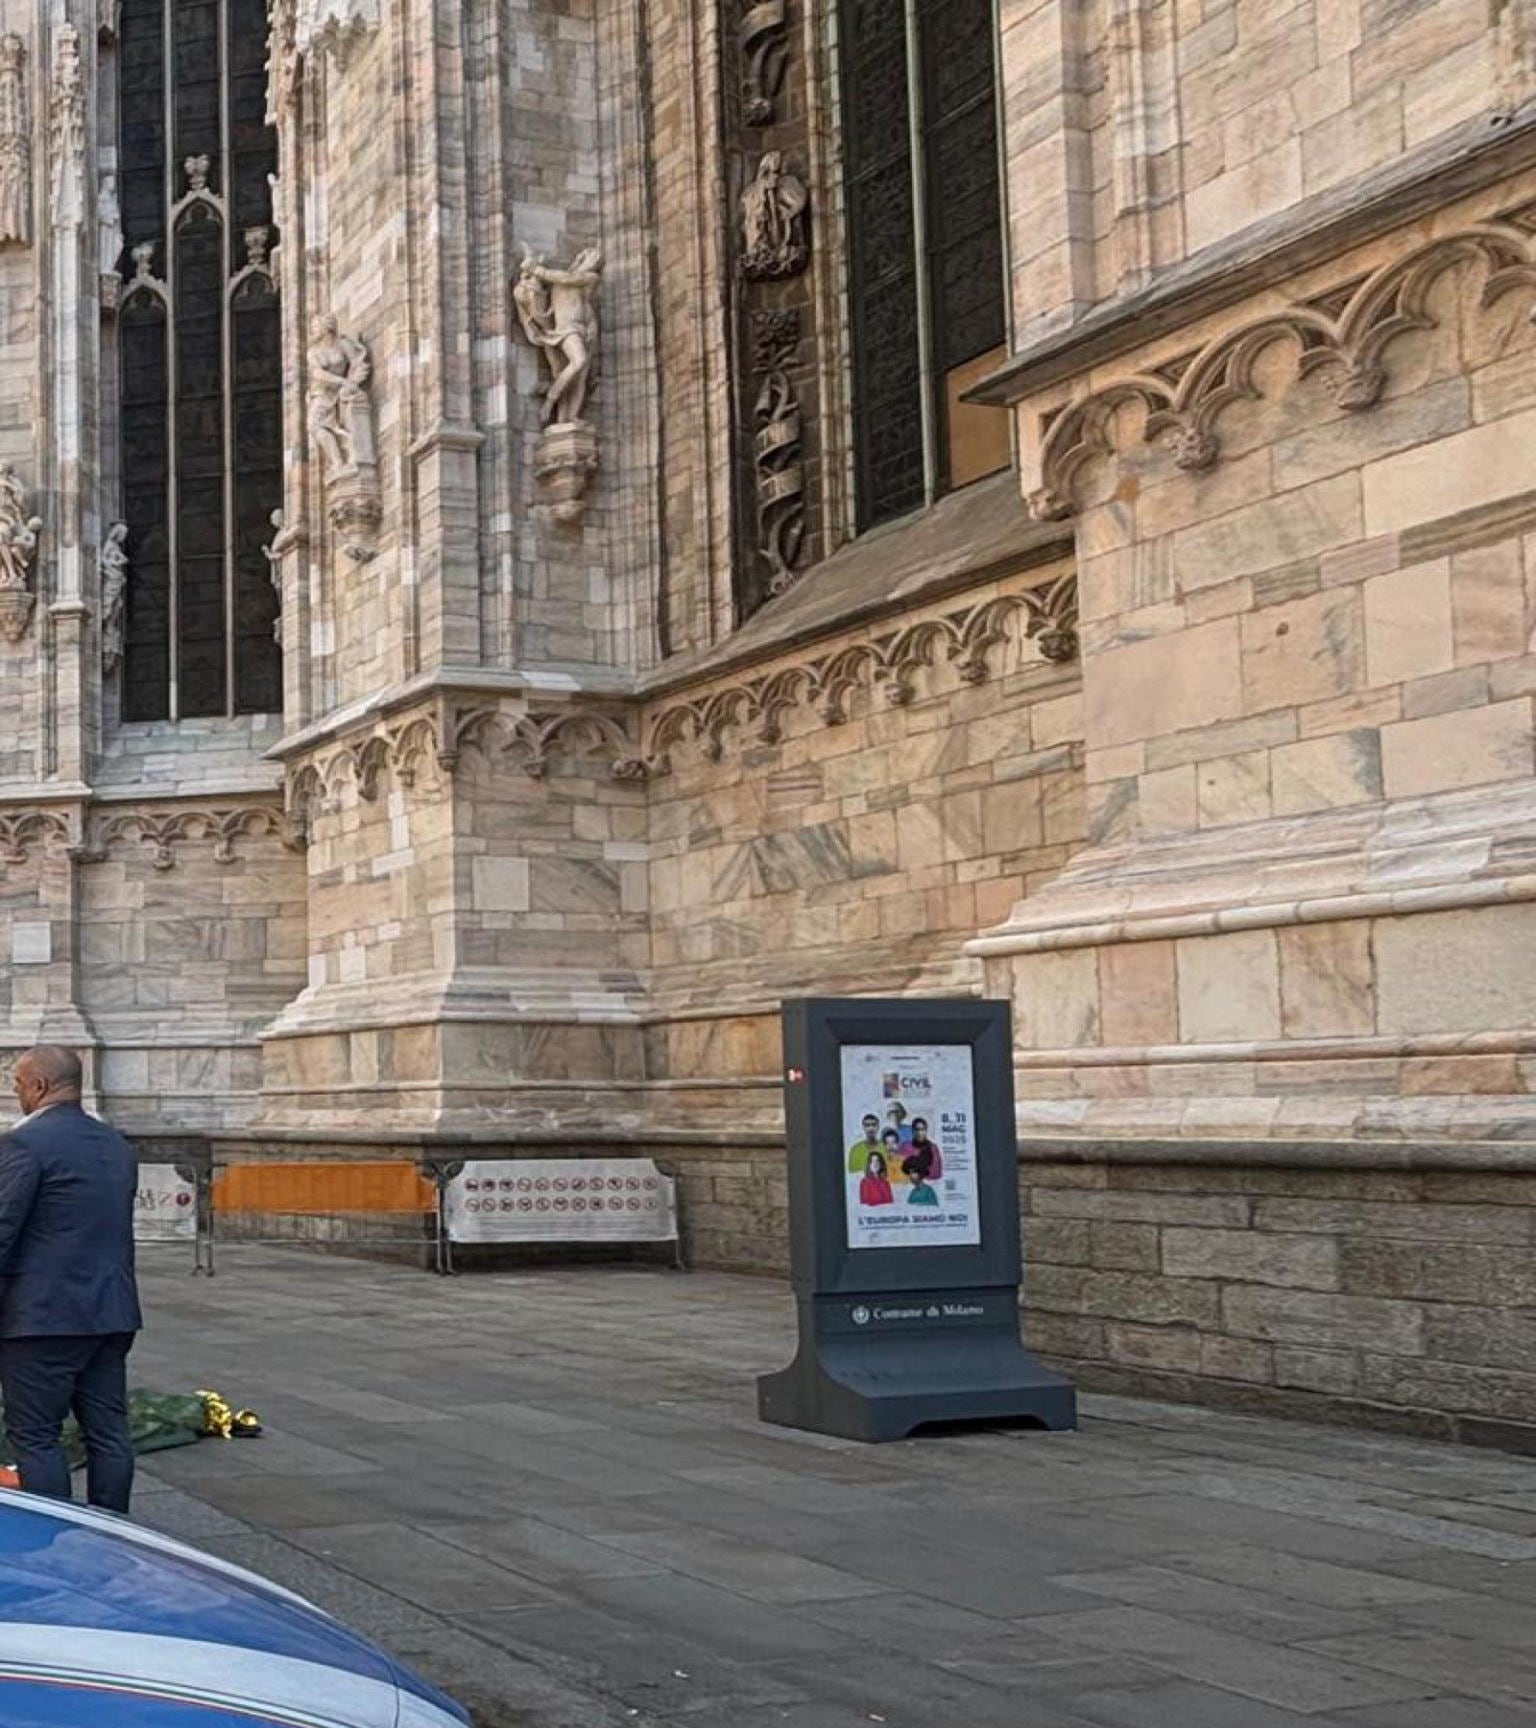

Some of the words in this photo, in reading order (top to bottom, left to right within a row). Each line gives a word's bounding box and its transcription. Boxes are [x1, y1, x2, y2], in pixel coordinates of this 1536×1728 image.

[872, 1307, 923, 1319] Comune
[926, 1305, 939, 1317] di
[943, 1304, 984, 1316] Milano
